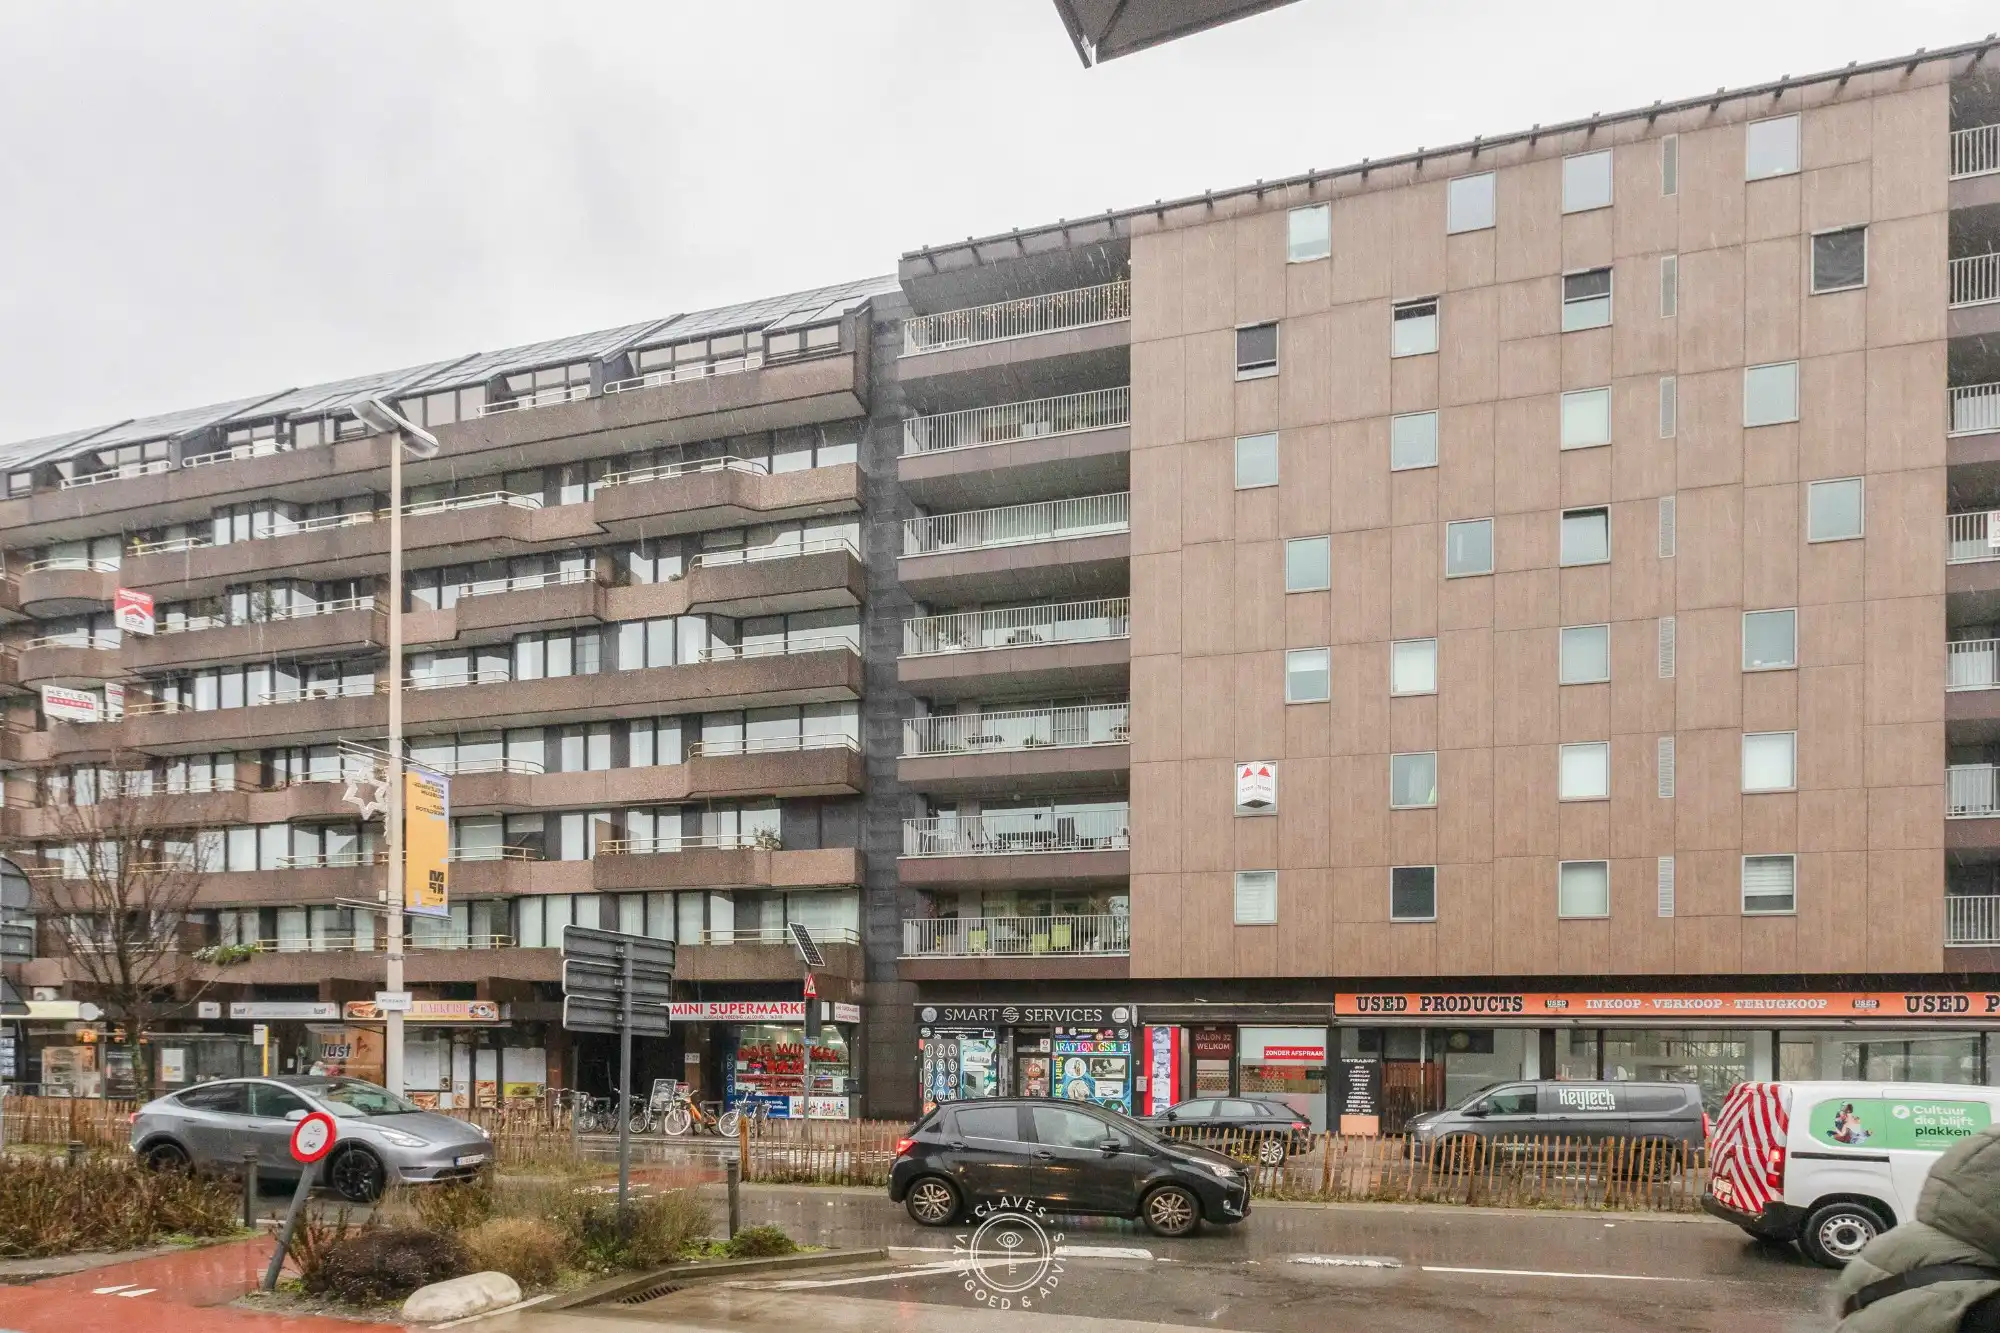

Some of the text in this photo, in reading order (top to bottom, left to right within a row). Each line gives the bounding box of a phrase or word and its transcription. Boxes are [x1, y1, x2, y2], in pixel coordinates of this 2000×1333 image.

[671, 1003, 805, 1015] MINI SUPERMARKE
[1356, 996, 1523, 1012] USED PRODUCTS
[1586, 999, 1642, 1009] INKOOP
[1652, 999, 1723, 1009] VERKOOP
[1733, 999, 1828, 1009] TERUGKOOP
[1904, 995, 1970, 1012] USED
[313, 1007, 327, 1015] lust
[944, 1009, 1103, 1022] SMART SERVICES
[1195, 1033, 1232, 1041] SALON 32
[323, 1043, 351, 1058] lust
[1098, 1042, 1117, 1052] GSM
[1558, 1088, 1616, 1110] KeyTech
[1912, 1105, 1967, 1116] Cultuur
[1913, 1115, 1975, 1129] die blijft
[1915, 1126, 1971, 1138] plakken
